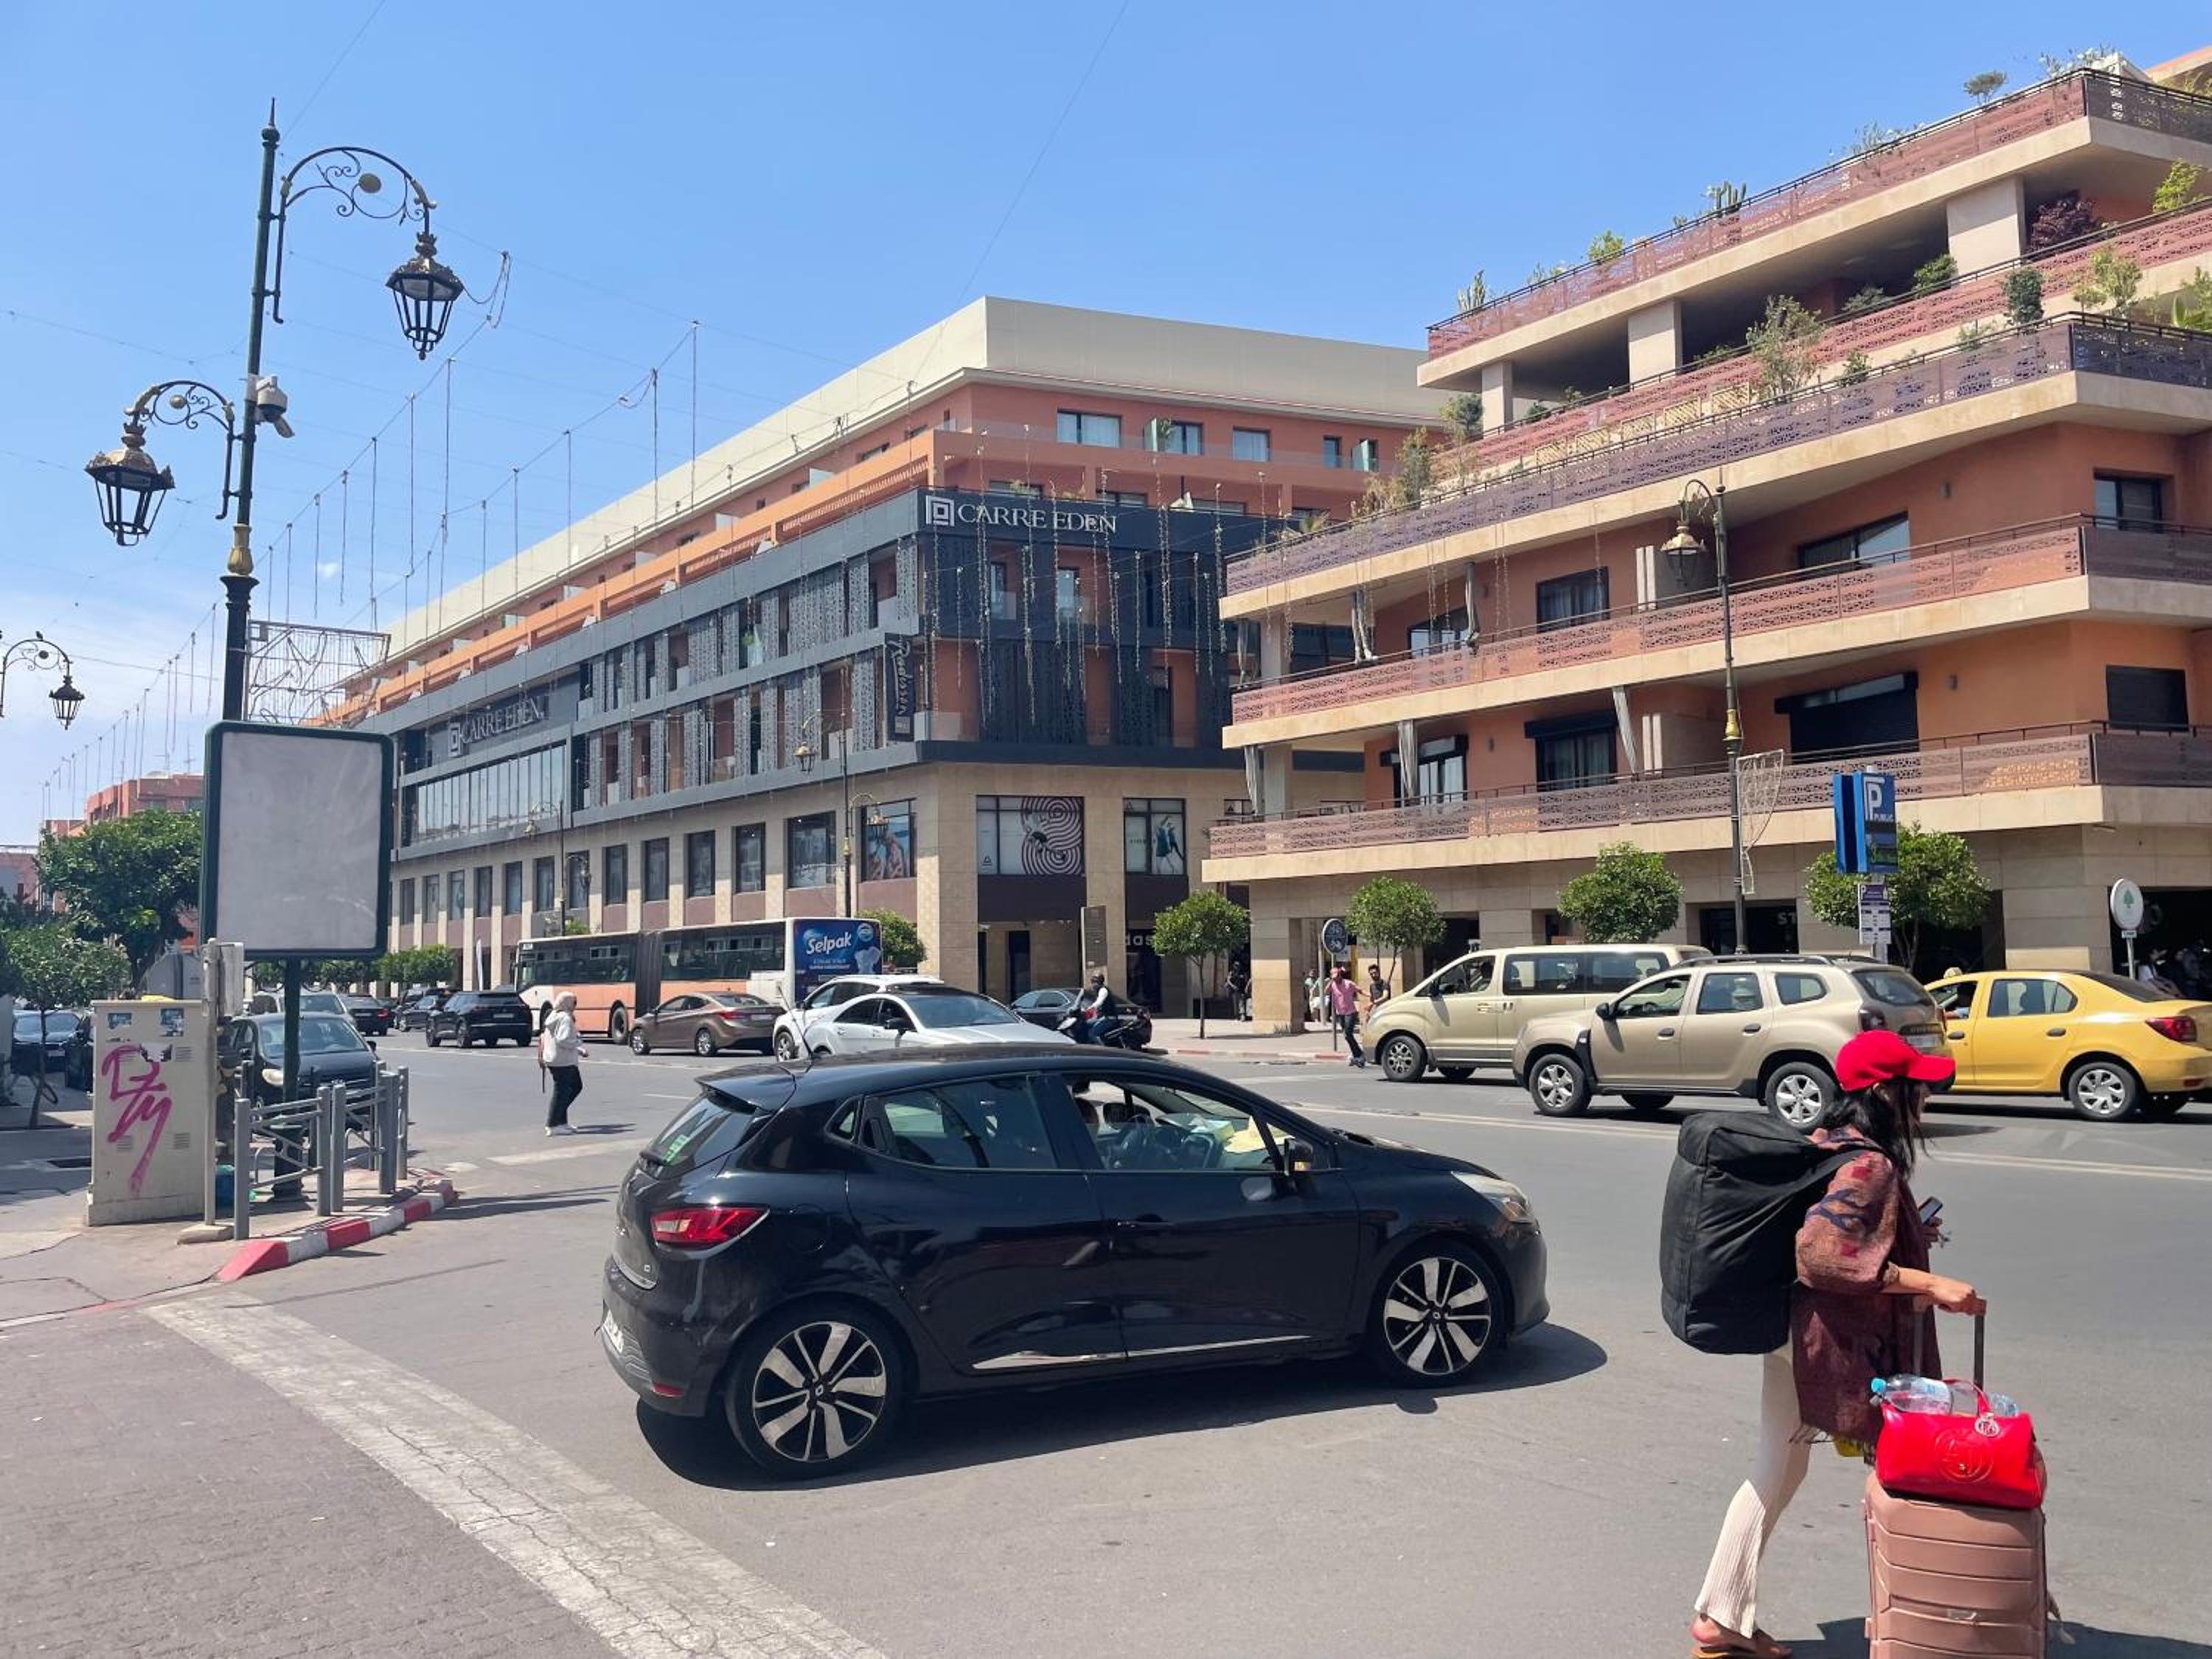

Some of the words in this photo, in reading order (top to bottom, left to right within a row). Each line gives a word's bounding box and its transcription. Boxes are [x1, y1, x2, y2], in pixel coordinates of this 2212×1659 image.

[958, 503, 1048, 529] CARRE
[1053, 510, 1117, 534] EDEN
[806, 931, 852, 955] Selpak
